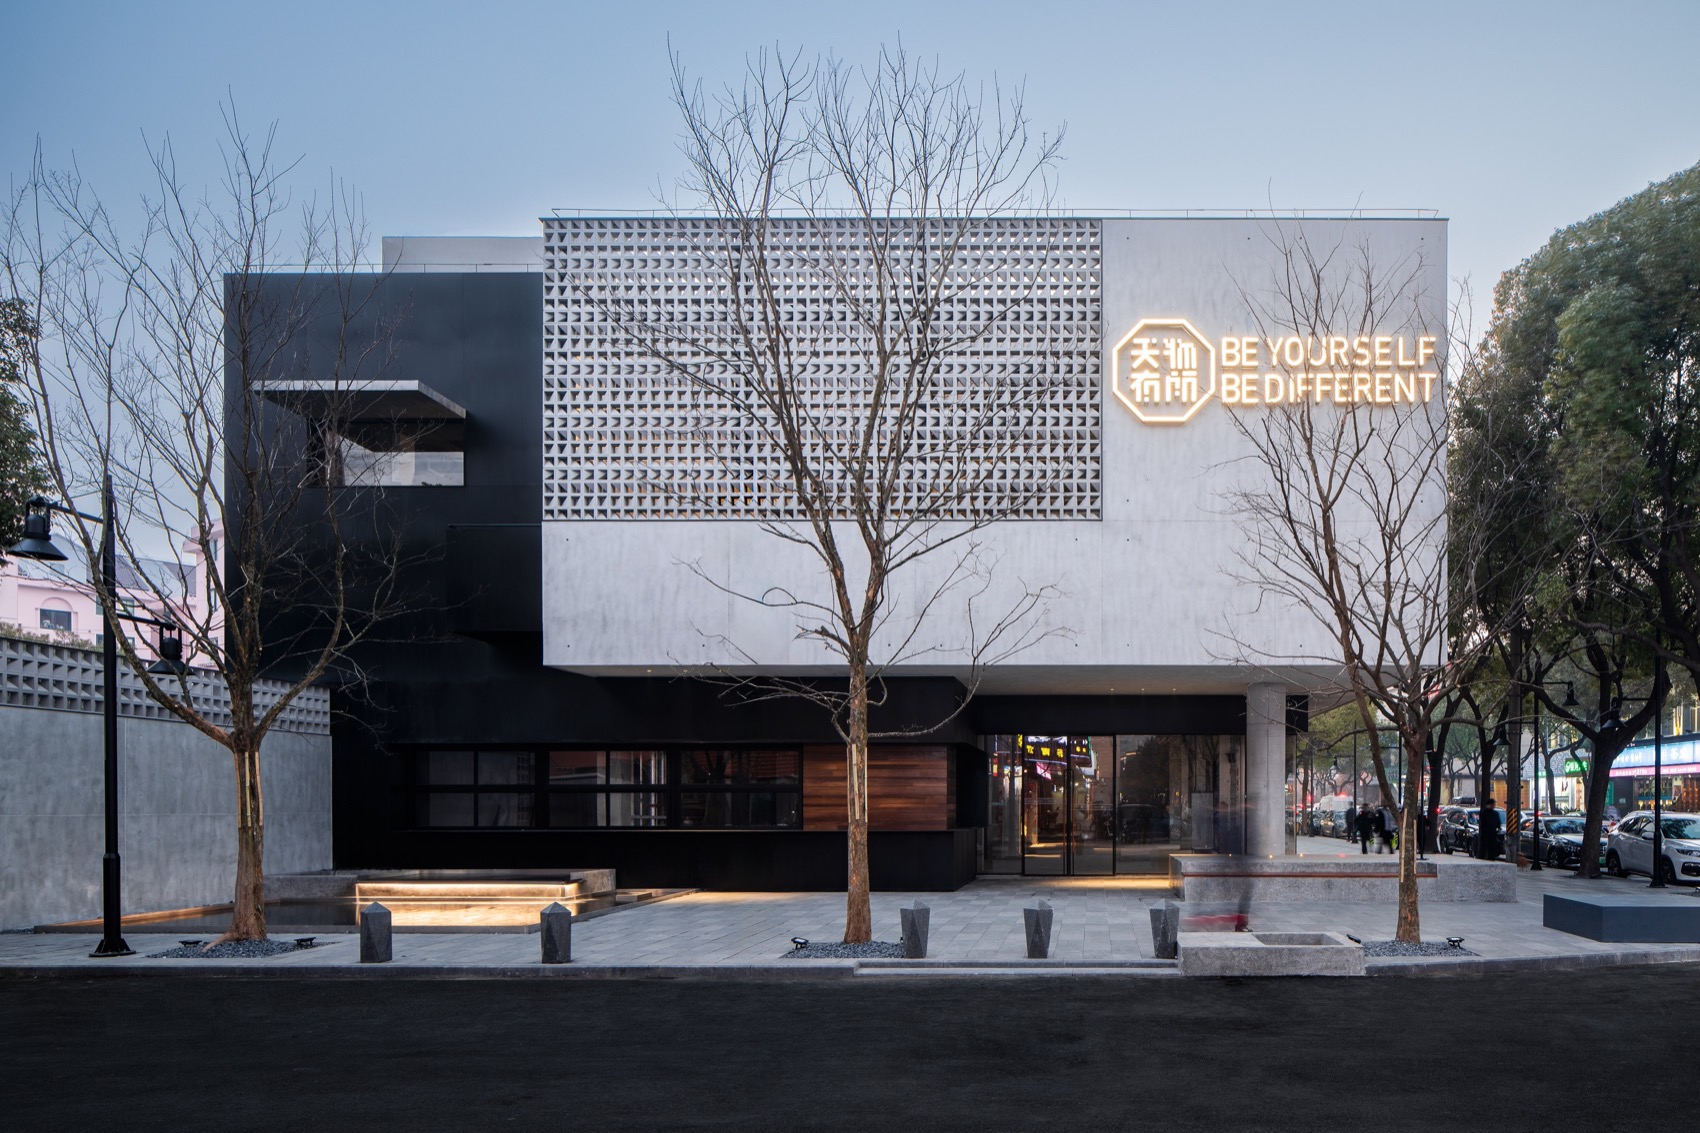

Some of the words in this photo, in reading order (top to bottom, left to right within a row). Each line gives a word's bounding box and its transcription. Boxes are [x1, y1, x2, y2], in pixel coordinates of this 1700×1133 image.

[1221, 336, 1259, 366] BE
[1265, 336, 1437, 366] YOURSELF
[1221, 373, 1259, 403] BE
[1264, 373, 1437, 403] DIFFERENT
